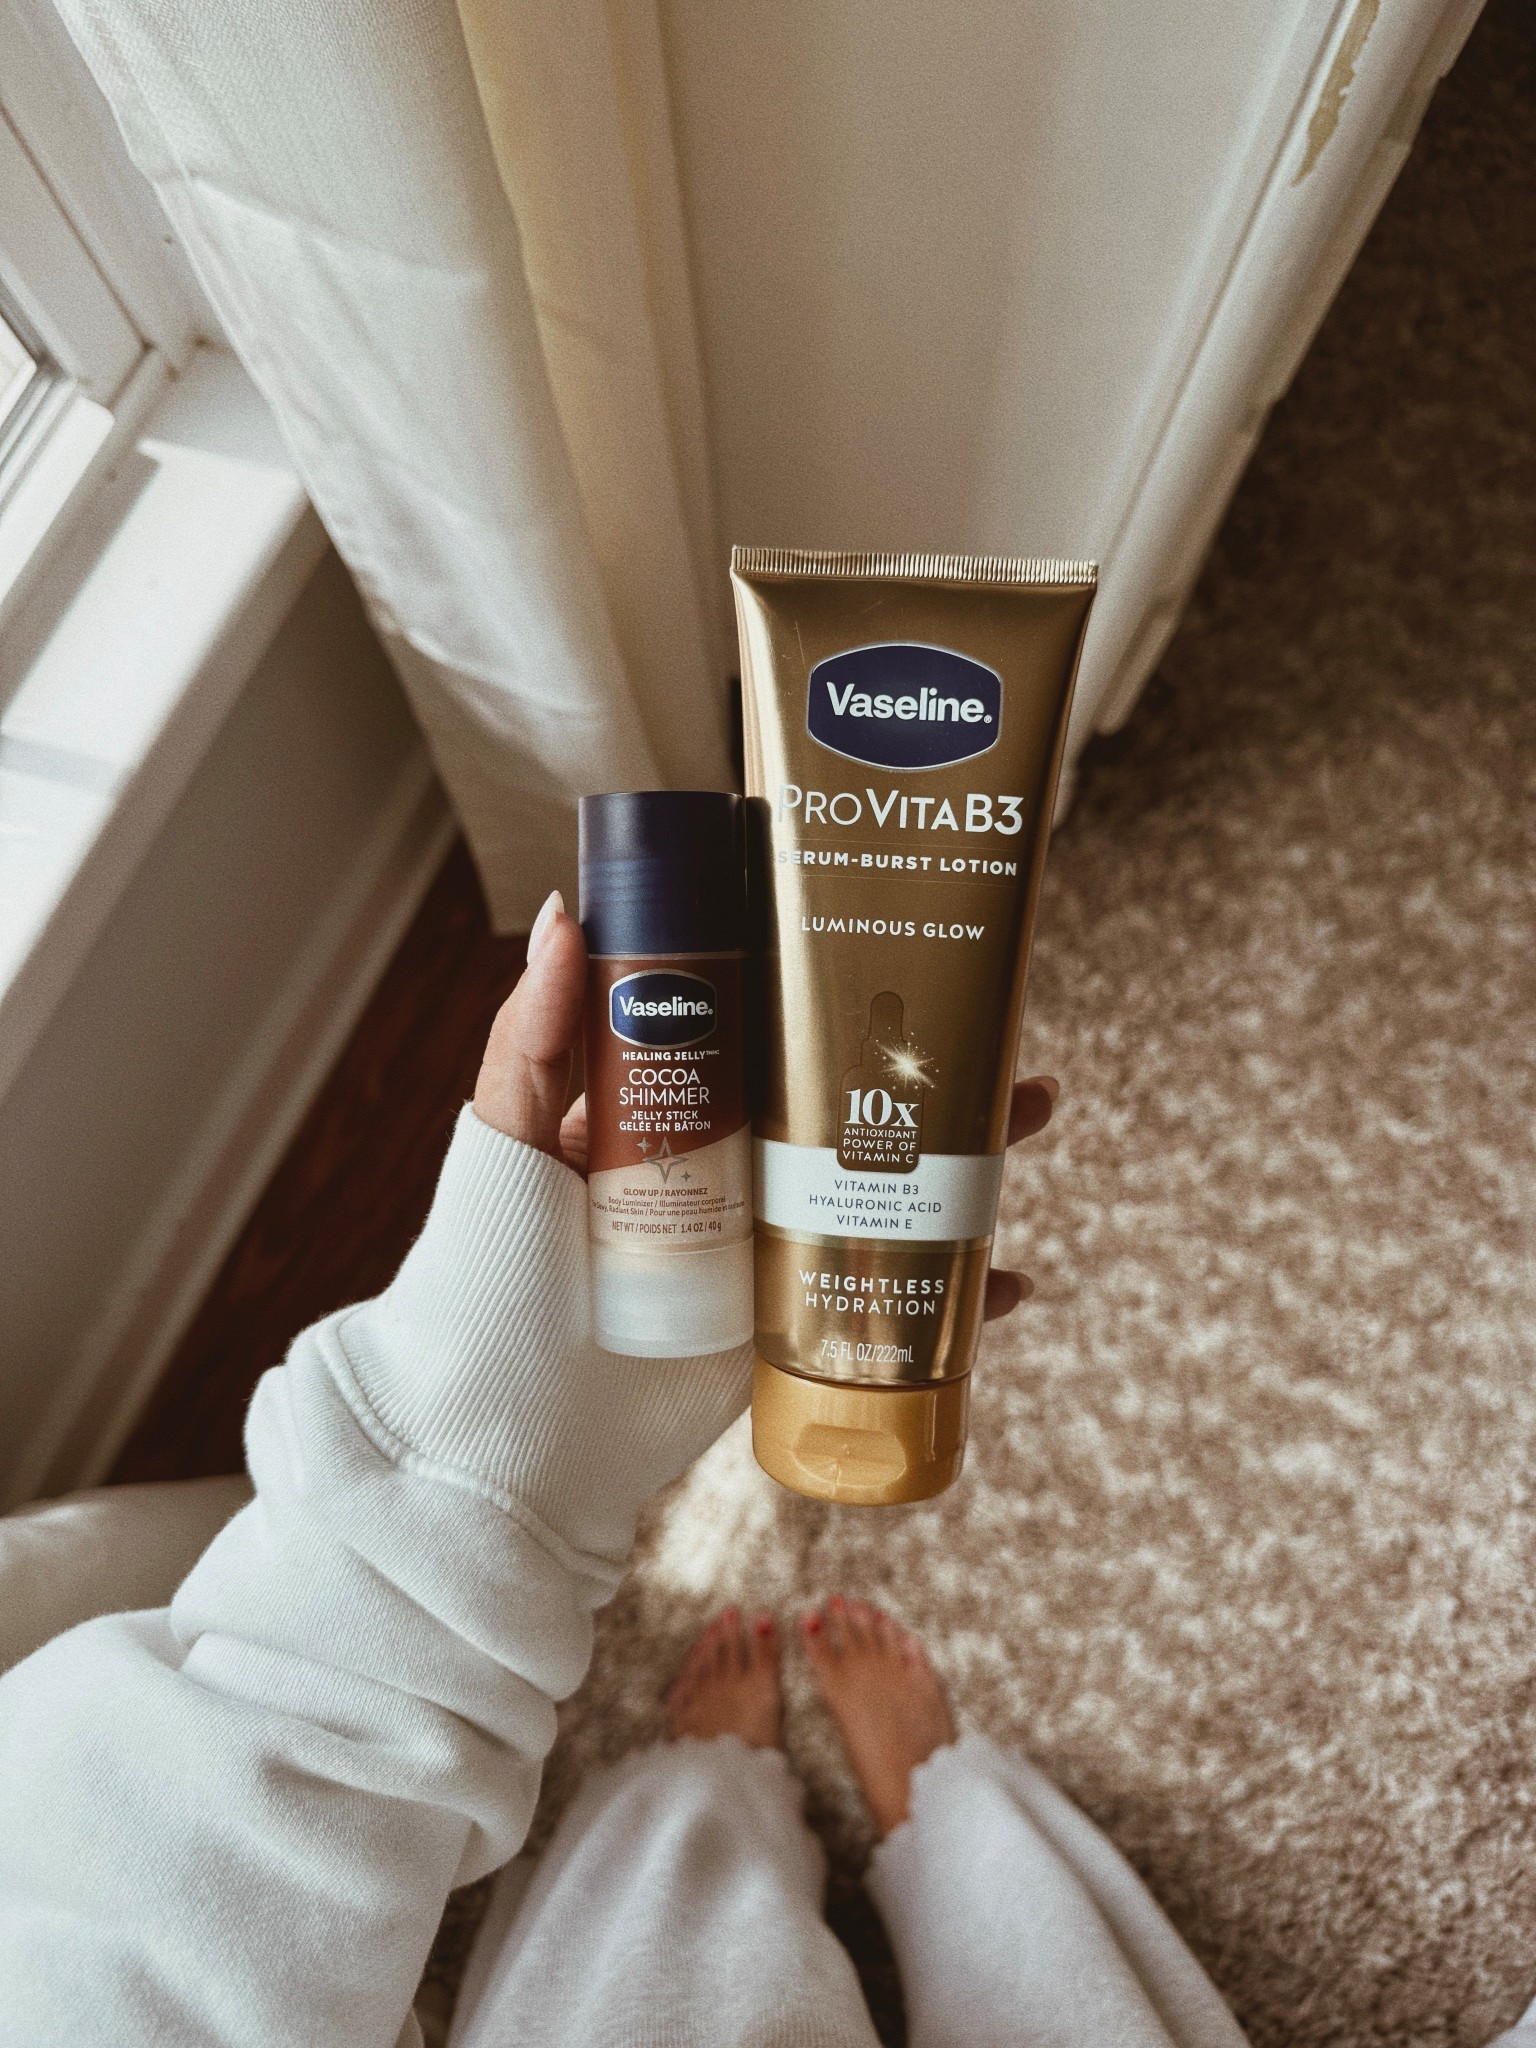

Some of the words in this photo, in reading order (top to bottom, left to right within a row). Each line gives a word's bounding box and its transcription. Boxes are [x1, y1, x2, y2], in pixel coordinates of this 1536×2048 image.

[778, 851, 932, 871] SERUM-BURST
[939, 858, 1017, 876] LOTION
[801, 916, 916, 937] LUMINOUS
[923, 922, 985, 941] GLOW
[622, 1051, 672, 1061] HEALING
[628, 1068, 701, 1085] COCOA
[619, 1086, 710, 1106] SHIMMER
[631, 1111, 662, 1121] JELLY
[666, 1110, 698, 1120] STICK
[844, 1088, 920, 1128] 10x
[619, 1120, 651, 1131] GELÉE
[655, 1122, 670, 1131] EN
[674, 1120, 711, 1131] BÂTON
[844, 1127, 917, 1139] ANTIOXIDANT
[843, 1138, 893, 1150] POWER
[898, 1141, 917, 1151] OF
[843, 1150, 900, 1163] VITAMIN
[905, 1153, 914, 1164] C
[623, 1188, 646, 1197] GLOW
[648, 1189, 659, 1197] UP
[665, 1187, 708, 1196] RAYONNEZ
[834, 1179, 897, 1194] VITAMIN
[903, 1184, 919, 1195] B3
[608, 1196, 622, 1206] Body
[623, 1199, 653, 1207] Luminizer
[659, 1200, 700, 1208] Illuminateur
[701, 1196, 726, 1206] corporel
[809, 1194, 902, 1212] HYALURONIC
[908, 1202, 942, 1213] ACID
[630, 1207, 644, 1216] Skin
[612, 1221, 623, 1231] NET
[624, 1222, 635, 1232] WT
[640, 1224, 661, 1234] POIDS
[663, 1224, 677, 1234] NET
[681, 1223, 692, 1233] 1.4
[693, 1222, 704, 1232] OZ
[836, 1214, 899, 1229] VITAMIN
[905, 1218, 913, 1229] E
[799, 1269, 945, 1295] WEIGHTLESS
[805, 1291, 936, 1316] HYDRATION
[821, 1339, 837, 1359] 7.5
[840, 1341, 854, 1360] FL
[857, 1343, 914, 1363] OZ/222mL
